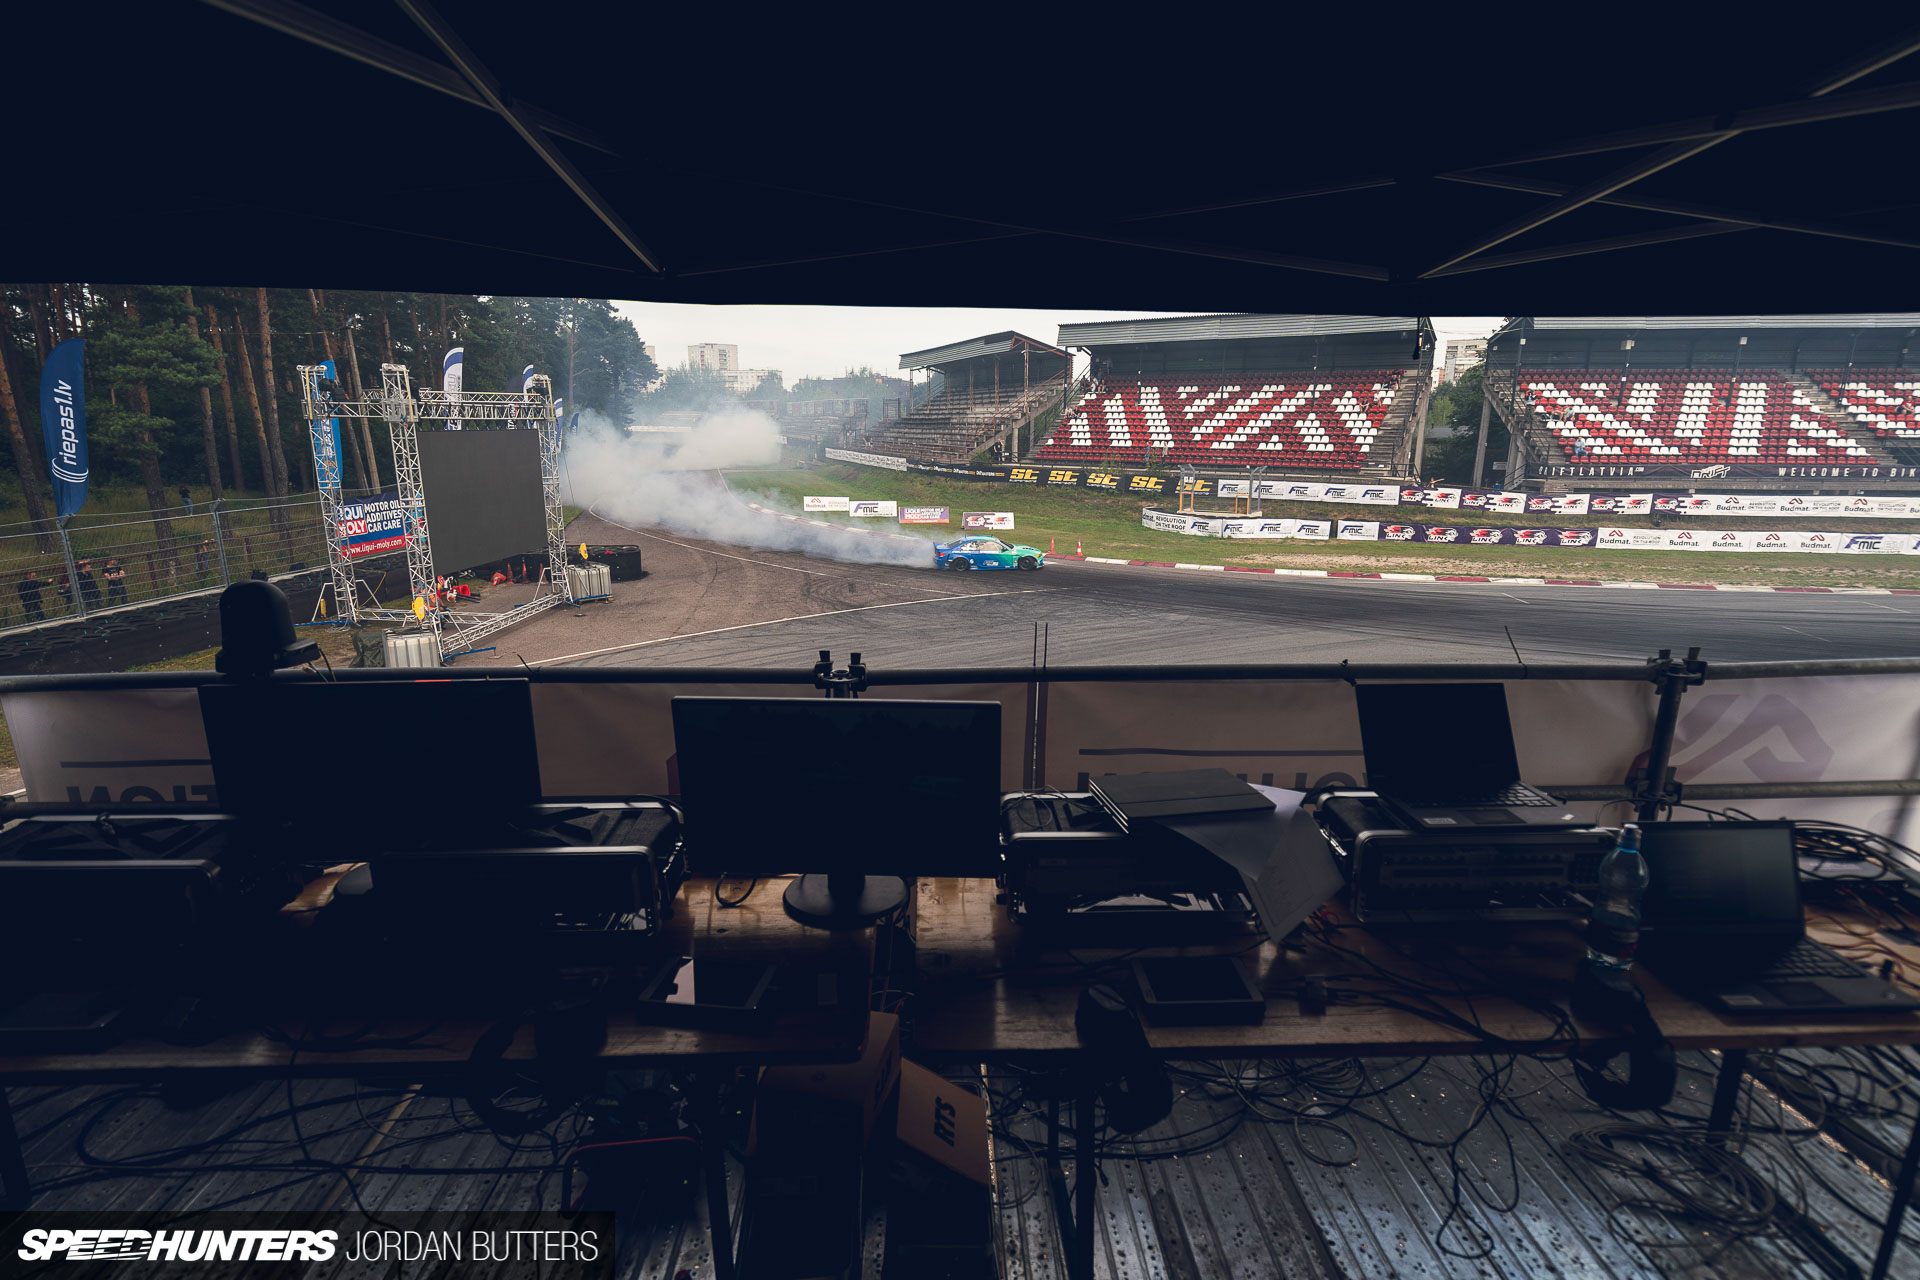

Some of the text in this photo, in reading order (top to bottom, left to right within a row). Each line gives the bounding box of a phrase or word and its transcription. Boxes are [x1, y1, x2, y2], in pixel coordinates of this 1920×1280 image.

[53, 379, 79, 466] riepas1.lv
[1778, 467, 1850, 477] WELCOME
[1862, 467, 1879, 477] TO
[364, 501, 389, 514] MOTOR
[853, 502, 879, 513] FMIC
[366, 509, 402, 523] ADDITIVES
[1155, 515, 1187, 525] REVOLUTION
[367, 519, 402, 533] CAR CARE
[1600, 537, 1631, 545] Budmat.
[1669, 539, 1700, 547] Budmat.
[1712, 540, 1743, 548] Budmat.
[1844, 535, 1884, 550] FMIC
[934, 1096, 956, 1147] RTS
